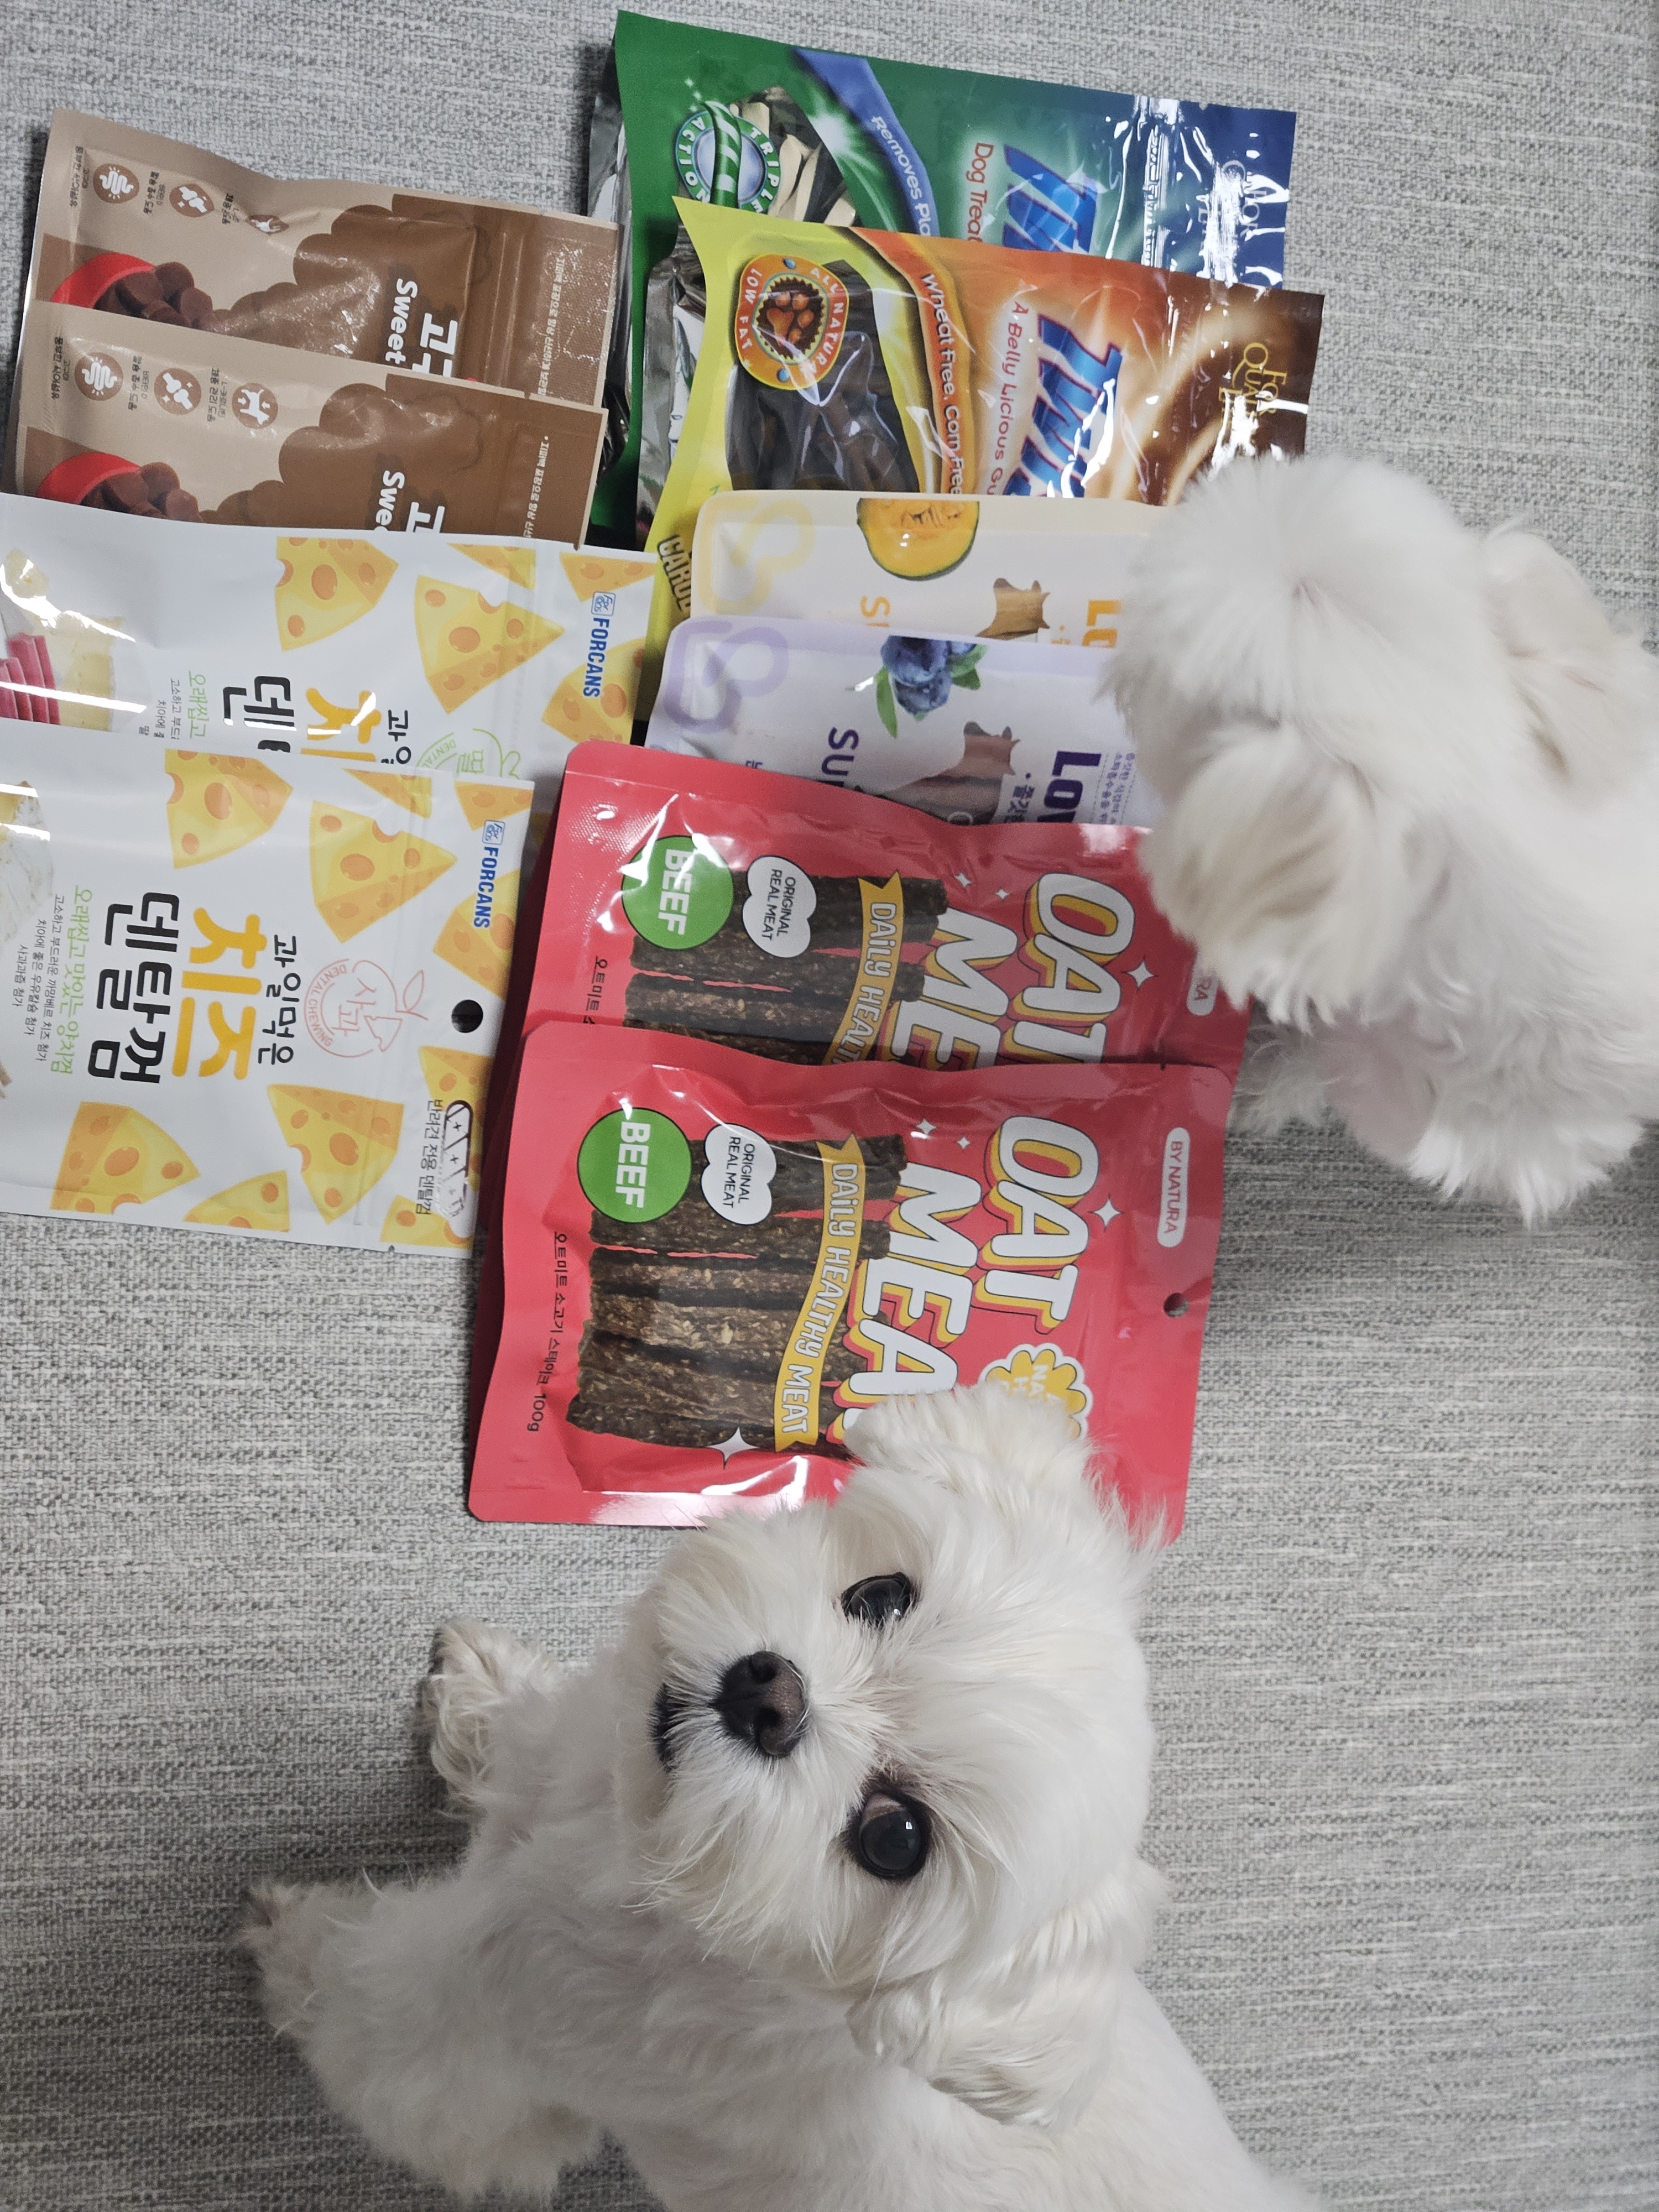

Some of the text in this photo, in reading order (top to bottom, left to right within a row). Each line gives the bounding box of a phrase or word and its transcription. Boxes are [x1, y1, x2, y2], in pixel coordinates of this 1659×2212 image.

[678, 117, 711, 204] ACTION
[749, 127, 780, 213] TRIPLE
[871, 116, 923, 200] Removes
[966, 142, 994, 184] Dog
[384, 278, 419, 364] Sweet
[738, 268, 763, 349] LOW FAT
[810, 267, 839, 294] ALL
[921, 274, 954, 345] Wheat
[1012, 301, 1029, 314] A
[50, 365, 61, 400] 식이섬유
[1001, 322, 1022, 375] Belly
[207, 405, 217, 422] 도움
[945, 405, 962, 450] Corn
[995, 383, 1017, 460] Licious
[530, 468, 544, 502] 포장으로
[949, 456, 965, 495] Free
[170, 678, 182, 714] 고소하고
[582, 617, 610, 698] FORCANS
[155, 700, 166, 729] 치아에
[187, 670, 210, 739] 오래씹고
[473, 846, 499, 929] FORCANS
[657, 847, 695, 936] BEEF
[760, 868, 783, 941] REAL MEAT
[775, 876, 797, 938] ORIGINAL
[12, 944, 29, 1008] 사과과즙 첨가
[23, 919, 48, 1036] 치아에 좋은 우유칼슘 첨가
[35, 894, 65, 1062] 고소하고 부드러운 까망베르 치즈 첨가
[50, 885, 93, 1075] 오래씹고 맛있는 양치껌
[87, 891, 180, 1084] 덴탈껌
[171, 907, 267, 1081] 치즈
[258, 934, 301, 1066] 과일먹은
[308, 964, 348, 1047] DENTAL CHEWING
[330, 978, 378, 1037] 사과
[587, 955, 608, 1013] 오트미트
[1011, 872, 1136, 1064] OAT
[415, 1099, 444, 1215] 반려견 전용 덴탈껌
[614, 1121, 651, 1208] BEEF
[721, 1136, 741, 1209] REAL MEAT
[737, 1143, 756, 1204] ORIGINAL
[1163, 1140, 1183, 1234] BY NATURA
[983, 1115, 1099, 1323] OAT
[527, 1231, 568, 1432] 오트미트 소고기 스테이크 100g
[780, 1162, 859, 1434] DAILY HEALTHY MEAT
[842, 1161, 982, 1431] MEA
